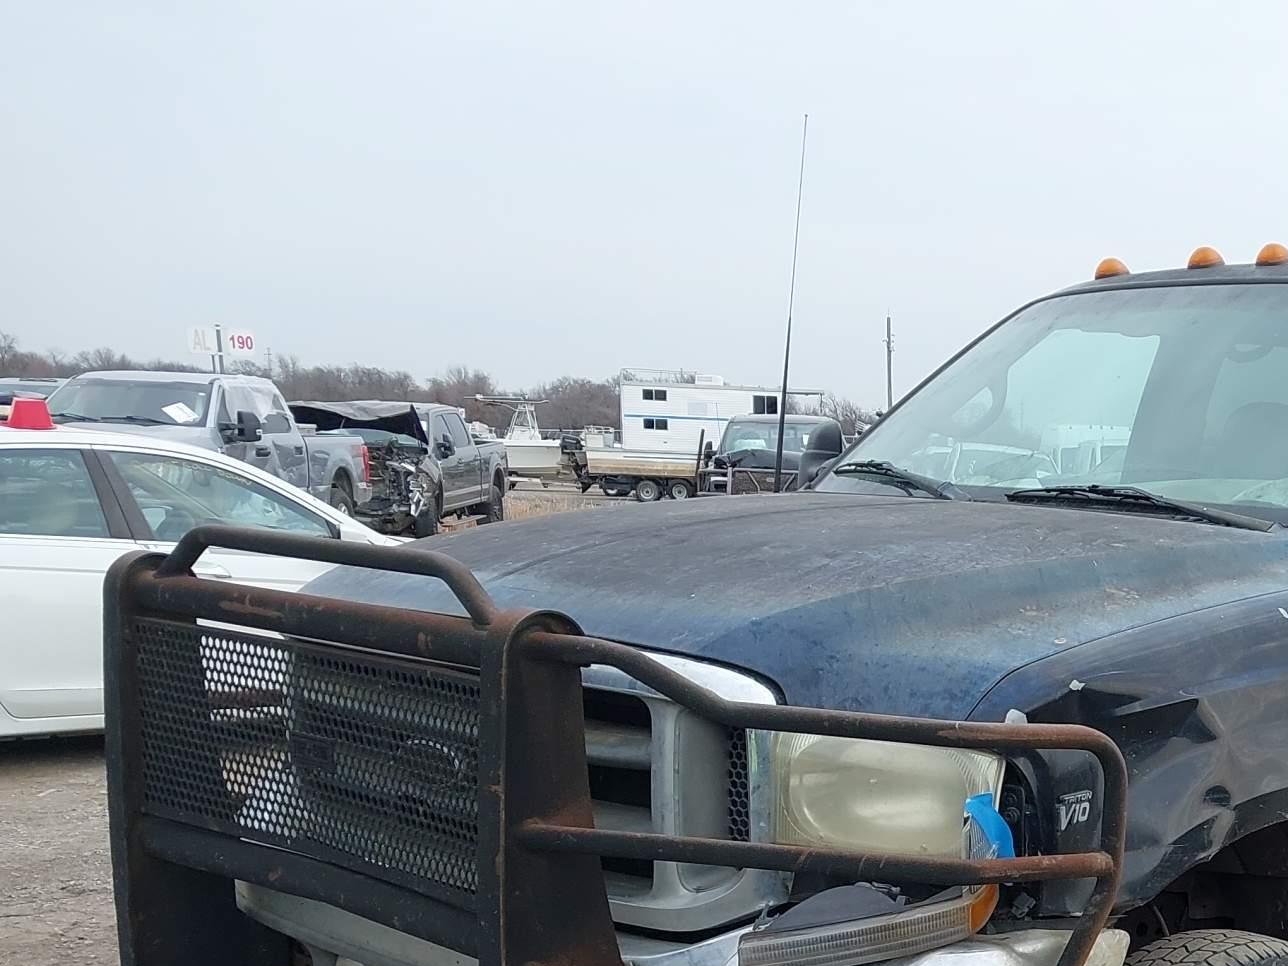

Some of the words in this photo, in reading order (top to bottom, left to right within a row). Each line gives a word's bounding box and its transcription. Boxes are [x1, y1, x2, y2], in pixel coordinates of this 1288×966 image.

[229, 334, 254, 350] 190
[1064, 791, 1093, 804] TRITON
[1060, 801, 1090, 831] V10
